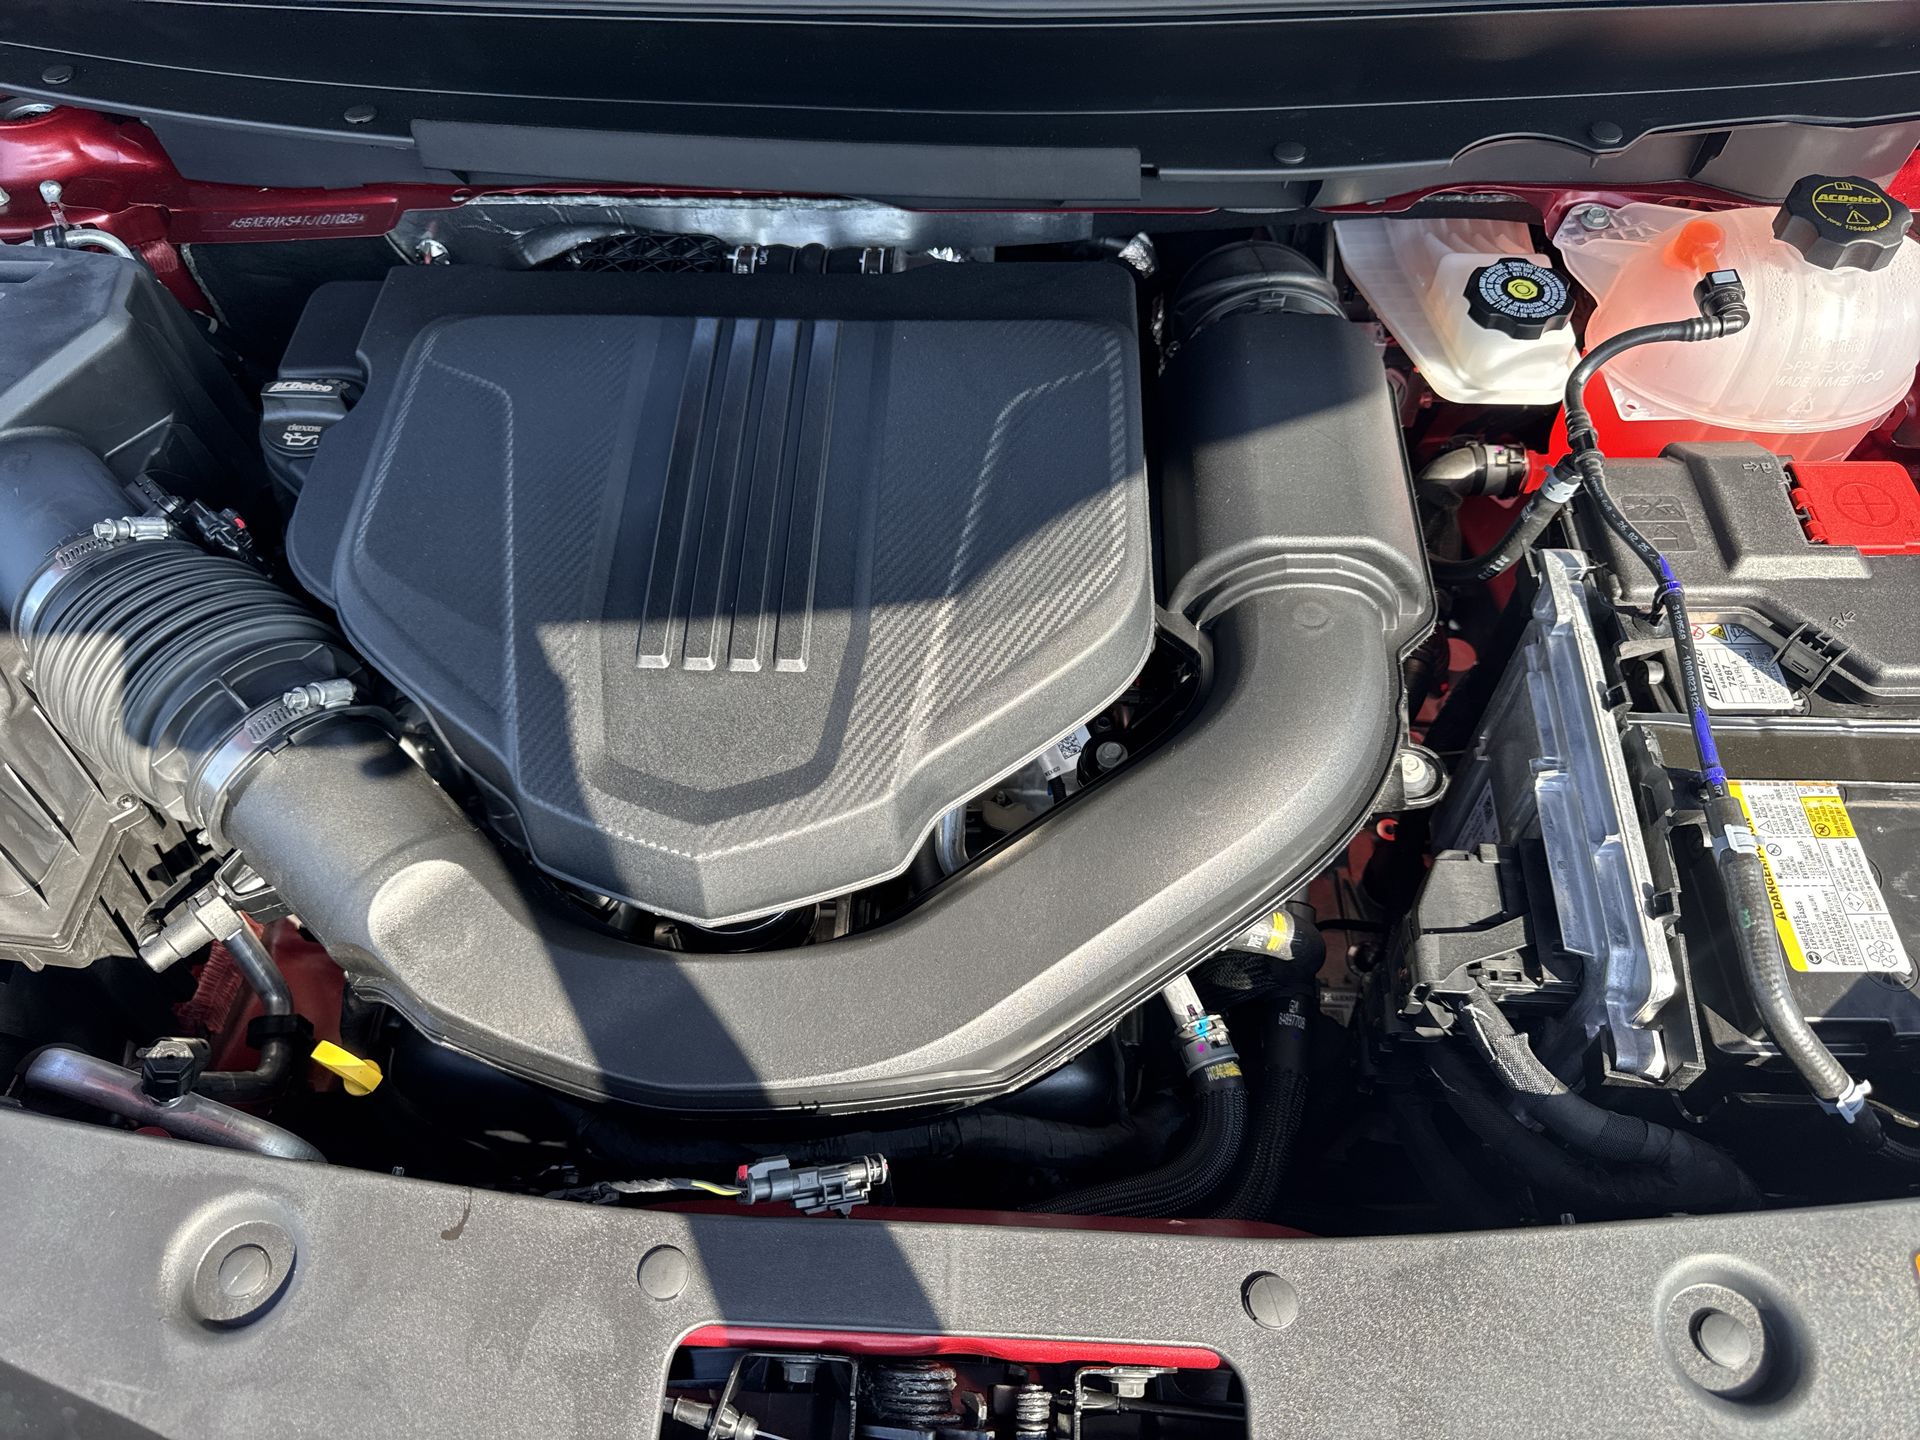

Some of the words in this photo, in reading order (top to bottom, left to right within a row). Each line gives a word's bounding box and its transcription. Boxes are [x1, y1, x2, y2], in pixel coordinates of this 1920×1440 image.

[1816, 193, 1882, 204] ACDelco
[267, 382, 333, 392] ACDelco
[1775, 375, 1811, 387] MADE
[1825, 370, 1885, 387] MEXICO
[287, 424, 322, 432] dexos
[1672, 604, 1687, 640] 3120568
[1696, 649, 1720, 700] ACDelco
[1722, 664, 1737, 687] 7287
